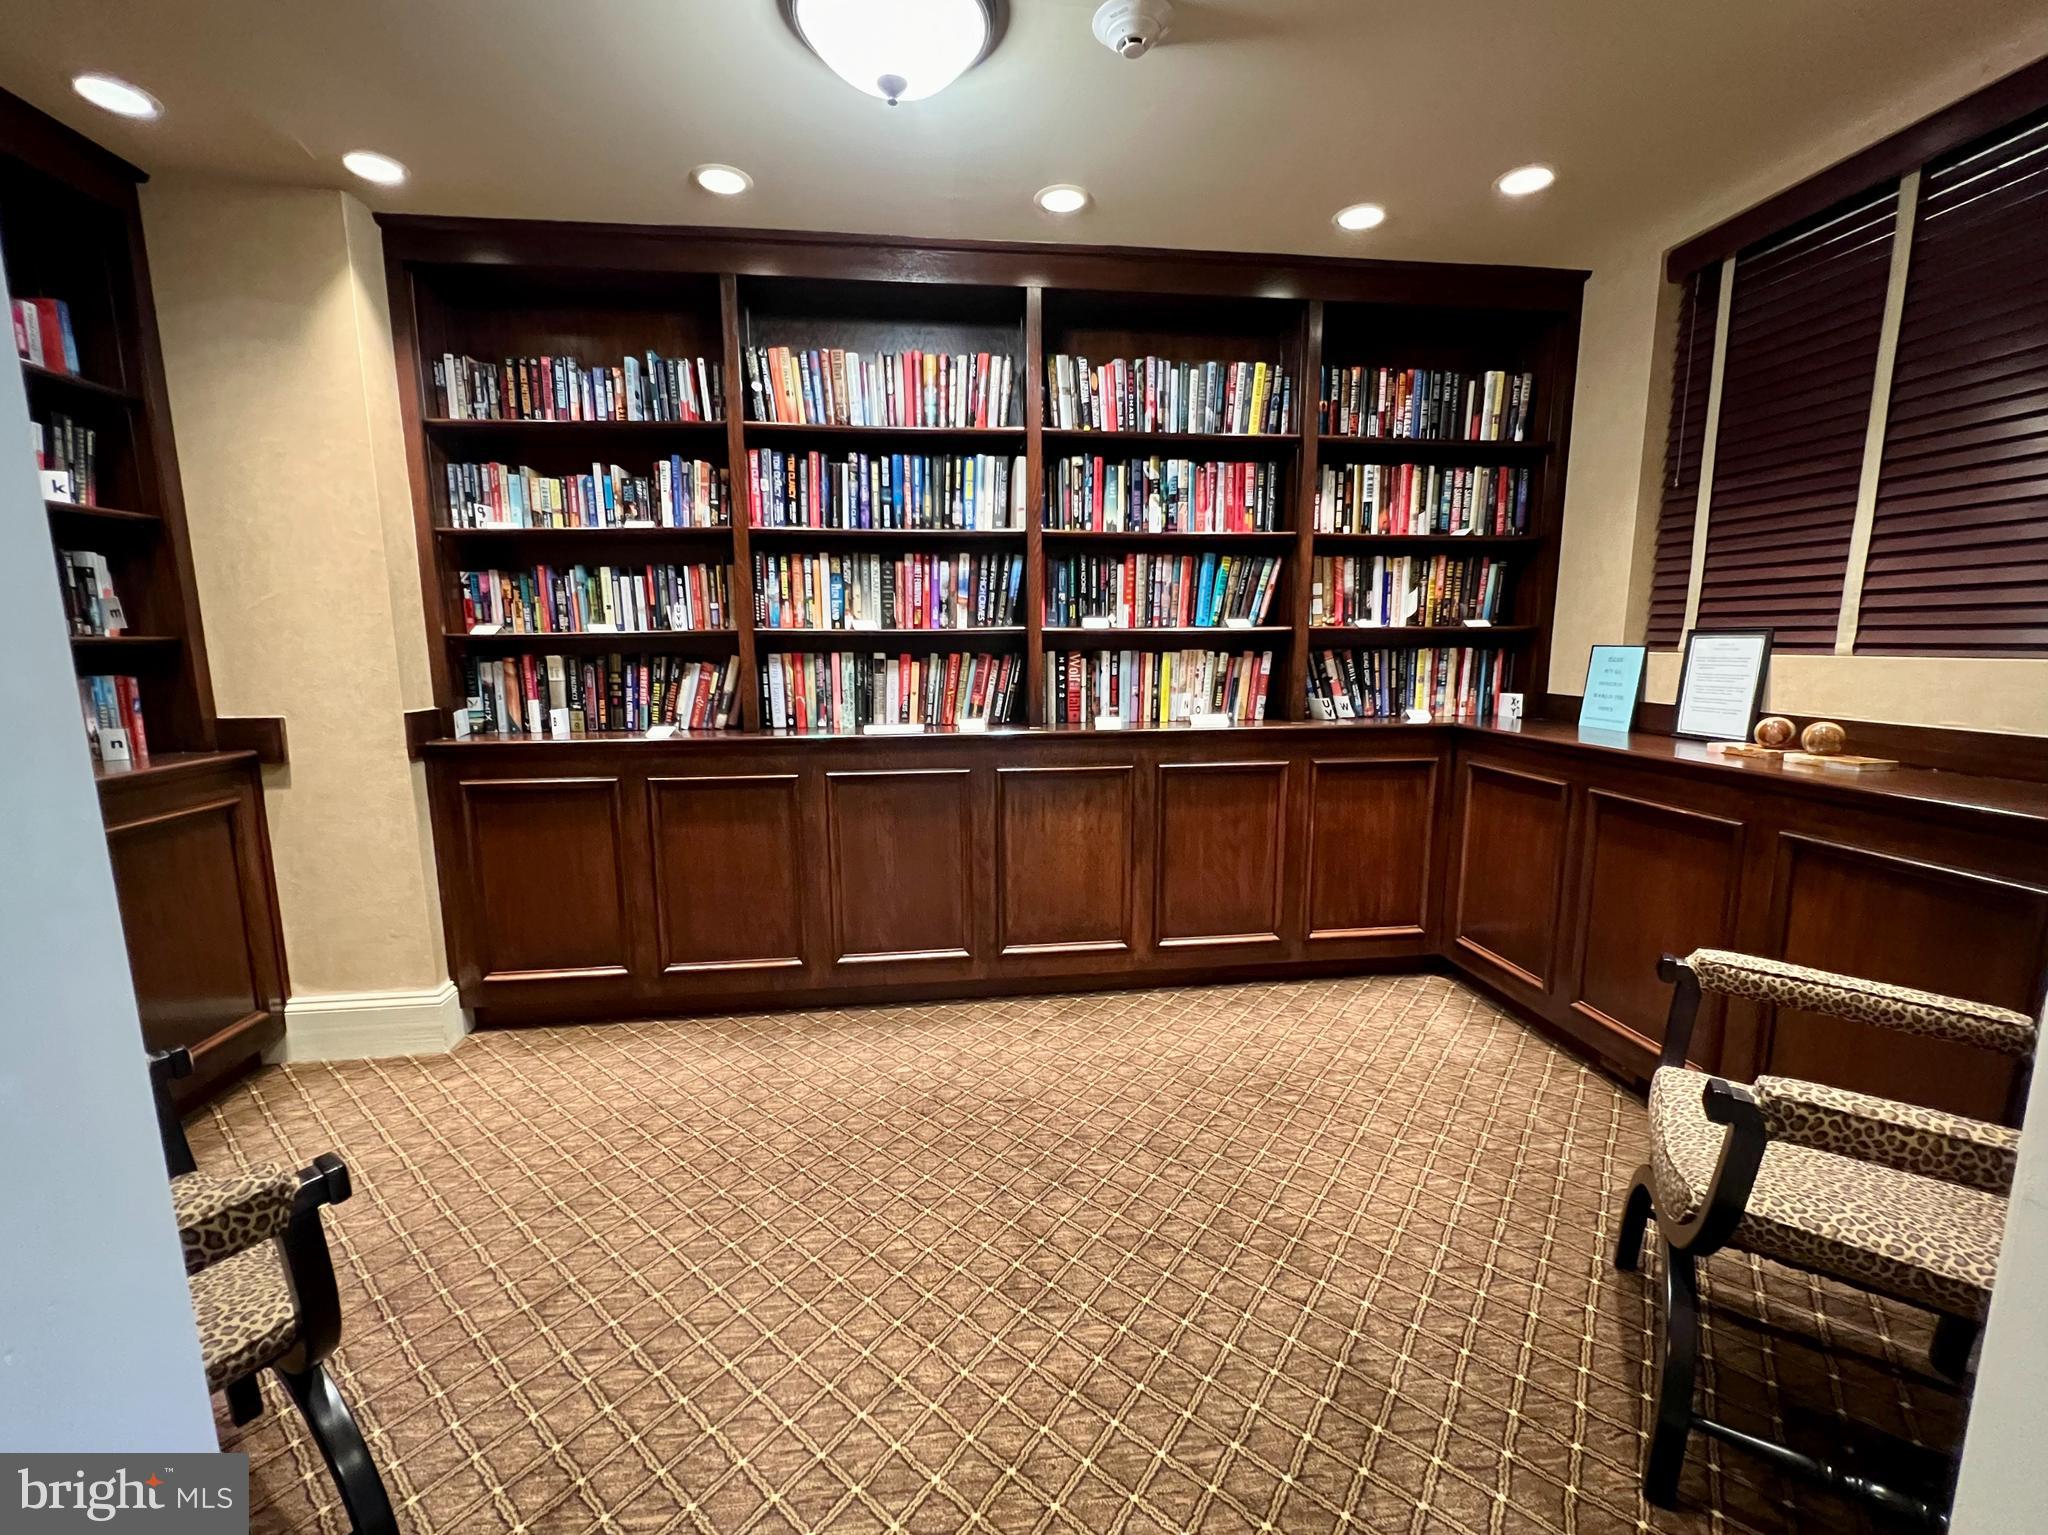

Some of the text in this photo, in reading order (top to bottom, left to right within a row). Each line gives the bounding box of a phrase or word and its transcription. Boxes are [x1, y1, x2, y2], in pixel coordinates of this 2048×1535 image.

[52, 479, 67, 494] k
[751, 469, 760, 496] CLANCY
[773, 455, 783, 497] TOM CLANCY
[788, 457, 797, 499] TOM CLANCY
[1464, 471, 1474, 487] JOHN
[978, 576, 988, 621] HIGH CRIMES
[1058, 656, 1066, 688] HEAT
[1069, 654, 1081, 682] Wolf
[1346, 658, 1356, 681] PERIL
[640, 667, 649, 705] SURRENDER
[1321, 699, 1330, 708] U
[1325, 709, 1333, 717] V
